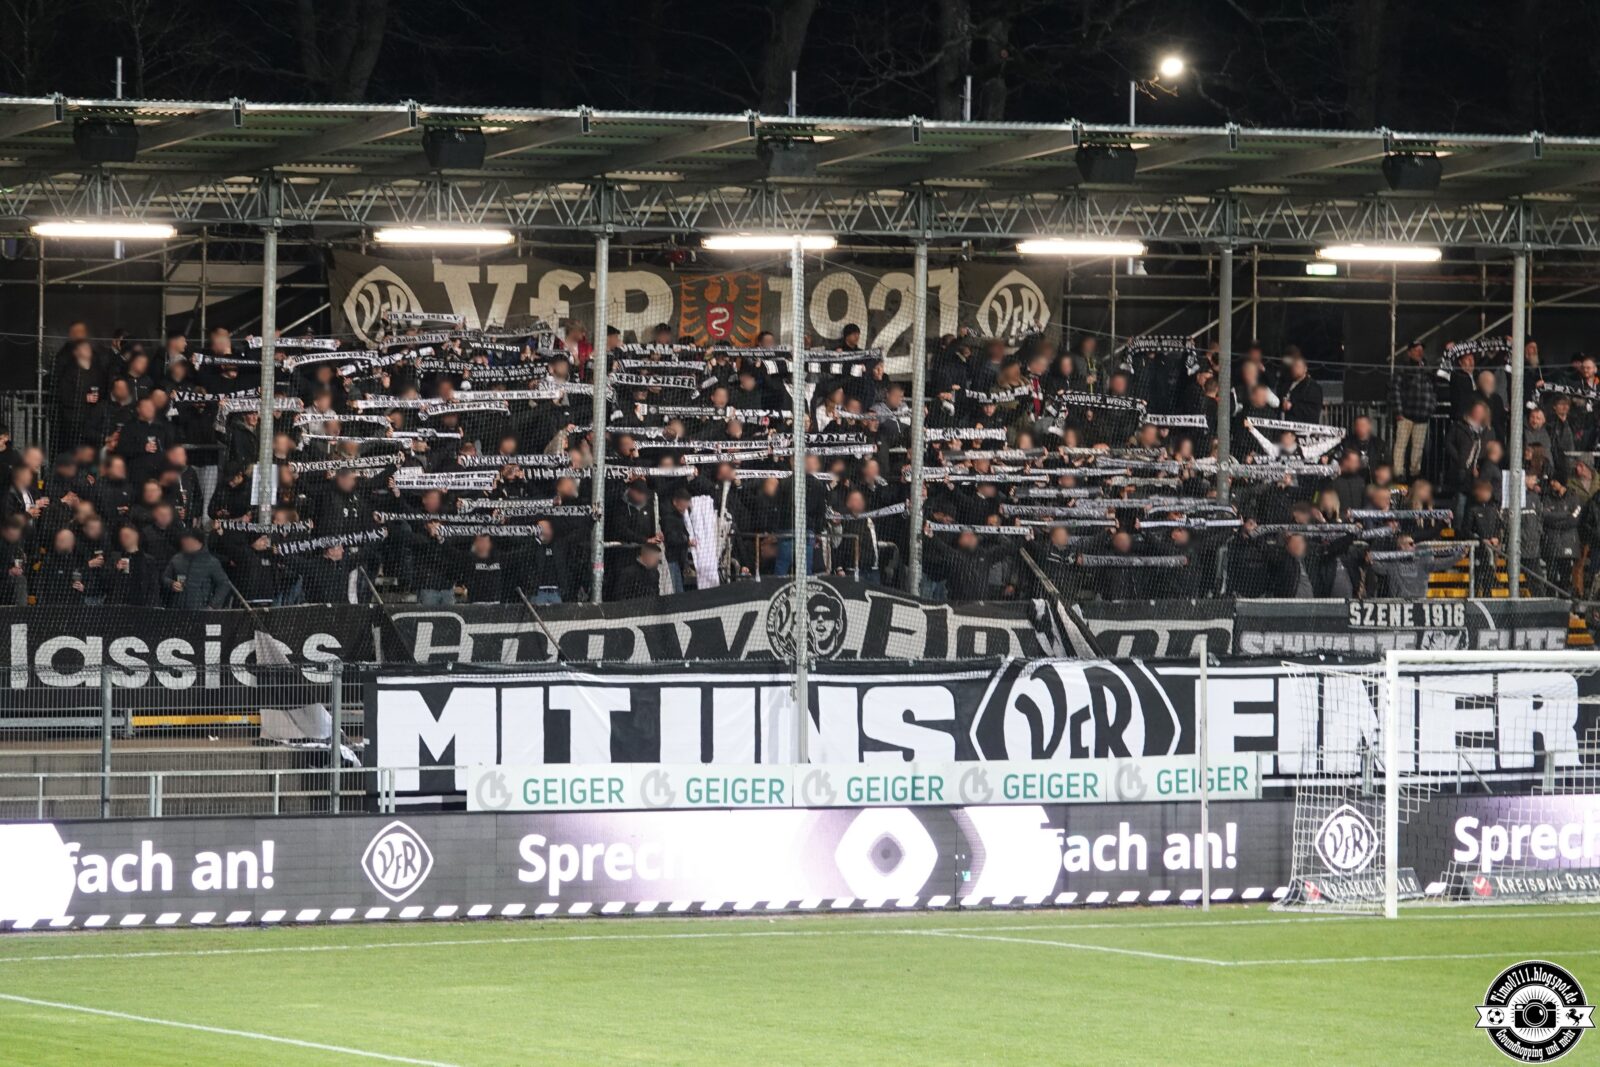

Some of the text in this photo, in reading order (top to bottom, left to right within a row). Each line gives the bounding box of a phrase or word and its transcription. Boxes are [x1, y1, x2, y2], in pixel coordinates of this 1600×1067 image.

[434, 264, 959, 374] VfR 1921
[396, 335, 416, 343] Aalen
[417, 333, 433, 342] 1921
[1350, 602, 1414, 627] SZENE
[376, 686, 632, 791] MIT
[659, 684, 956, 764] UNS
[1194, 671, 1582, 780] EINER
[522, 777, 625, 807] GEIGER
[685, 776, 787, 805] GEIGER
[846, 775, 945, 803] GEIGER
[1002, 772, 1100, 801] GEIGER
[1156, 765, 1250, 796] GEIGER
[1162, 822, 1238, 870] an!
[192, 840, 275, 891] an!
[1496, 876, 1563, 894] KREISBAU
